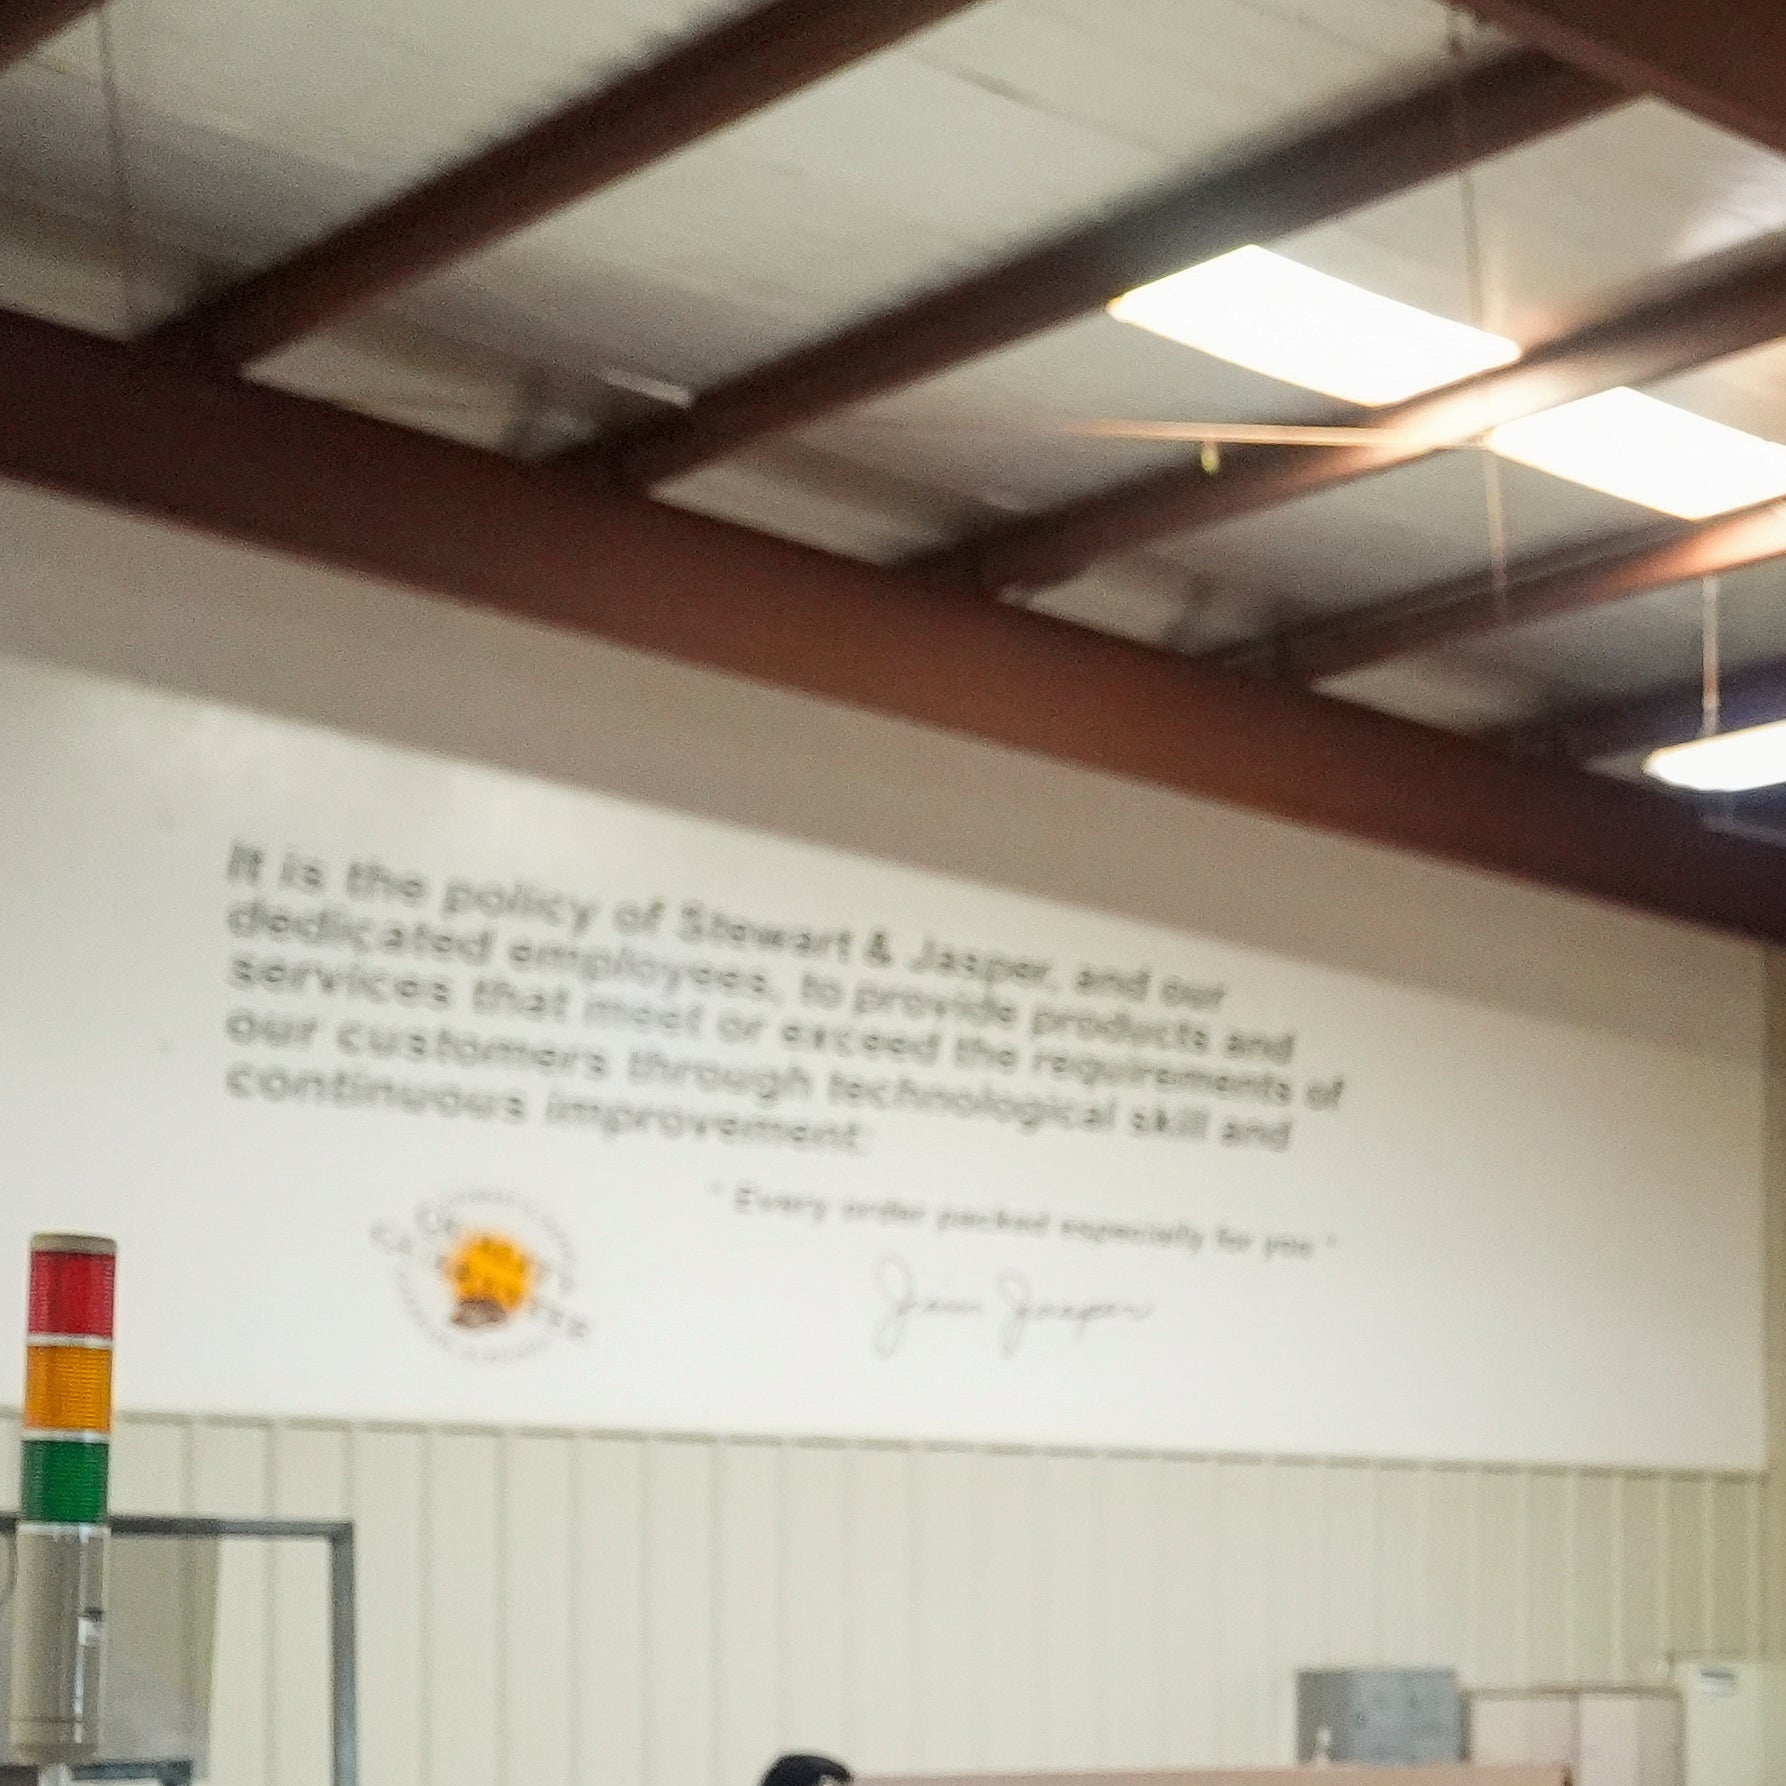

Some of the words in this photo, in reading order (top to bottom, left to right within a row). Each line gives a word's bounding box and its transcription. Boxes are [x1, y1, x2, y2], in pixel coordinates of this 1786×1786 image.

[228, 842, 264, 885] It
[279, 853, 323, 893] is
[346, 860, 427, 904] the
[443, 880, 592, 936] policy
[613, 896, 667, 936] of
[679, 904, 851, 960] Stewart
[862, 925, 893, 967] &
[1074, 963, 1152, 1003] and
[1160, 974, 1225, 1012] our
[228, 903, 492, 962] dedicated
[801, 972, 843, 1008] to
[854, 978, 1018, 1028] provide
[1031, 1004, 1210, 1056] products
[1226, 1028, 1296, 1066] and
[226, 1007, 318, 1048] our
[338, 1024, 605, 1077] customers
[627, 1047, 812, 1110] through
[827, 1069, 1117, 1138] technological
[1128, 1103, 1210, 1141] skill
[1221, 1112, 1293, 1152] and
[227, 1066, 525, 1120] continuous
[230, 960, 450, 1009] services
[473, 980, 571, 1025] that
[583, 998, 704, 1042] meet
[716, 1005, 763, 1045] or
[780, 1017, 941, 1068] exceed
[955, 1033, 1018, 1075] the
[1033, 1054, 1292, 1107] requirements
[1304, 1074, 1344, 1112] of
[841, 1194, 927, 1222] order
[937, 1203, 1050, 1233] packed
[1060, 1215, 1203, 1257] especially
[1214, 1222, 1253, 1250] for
